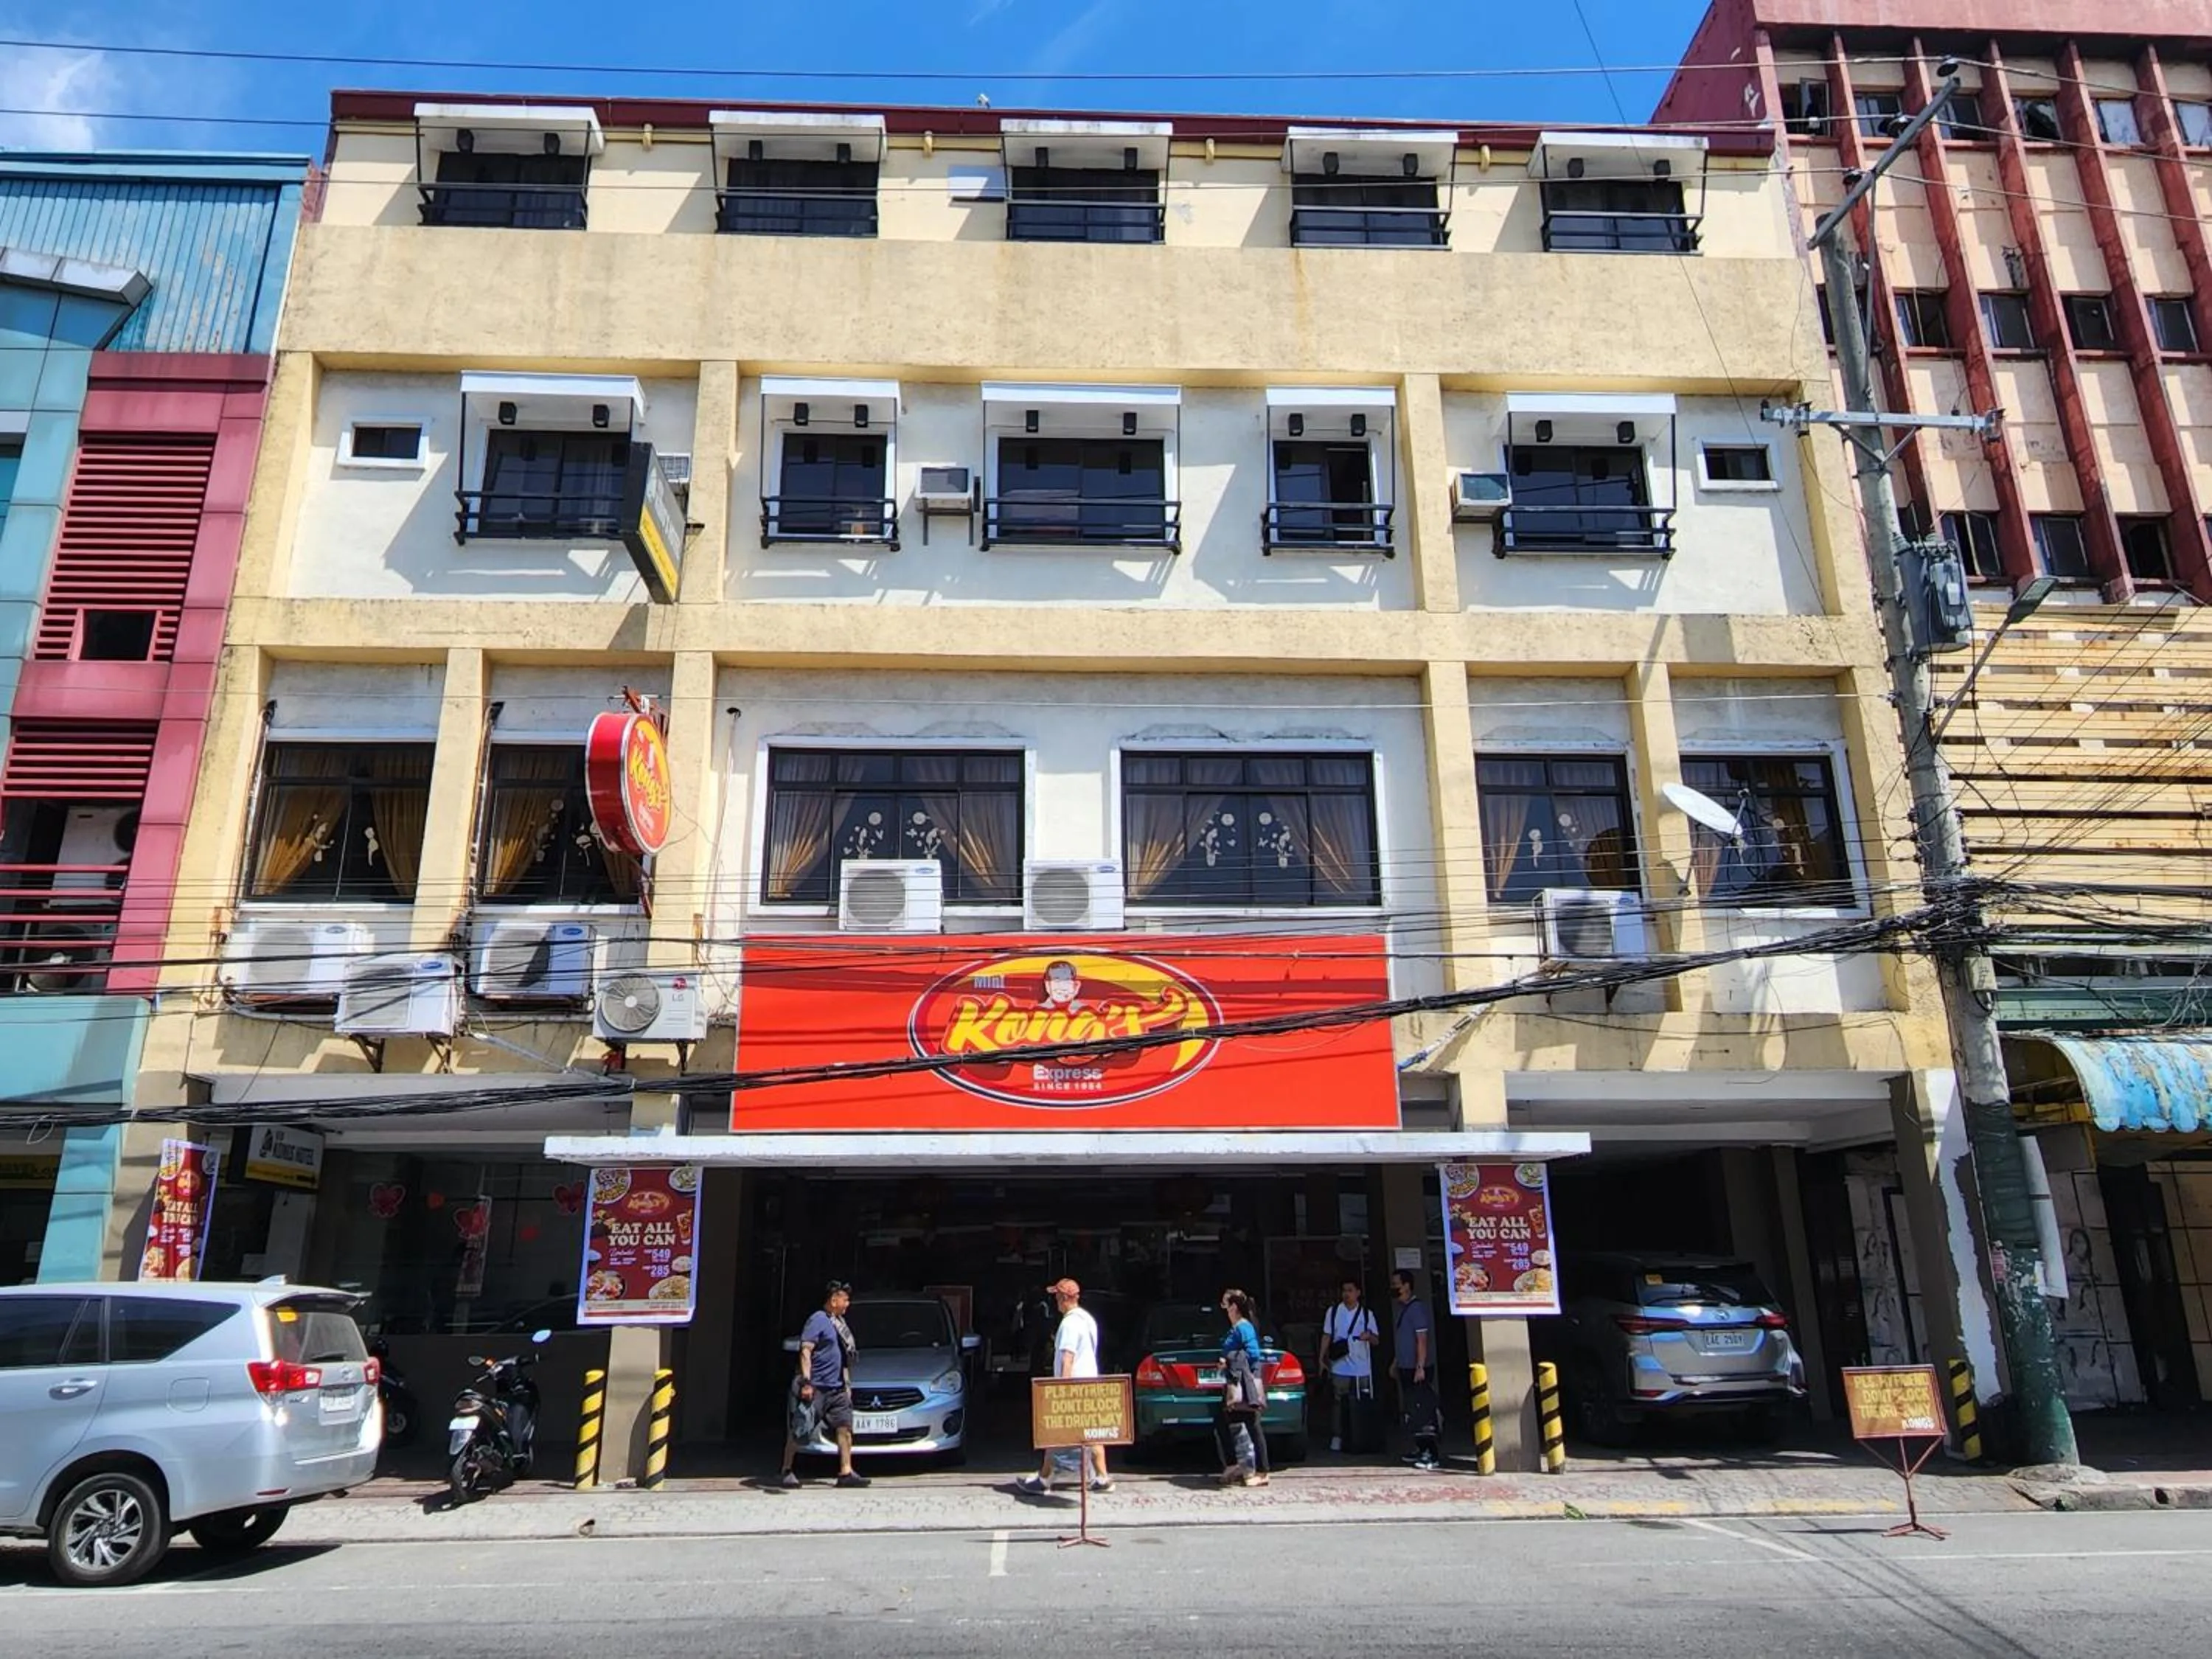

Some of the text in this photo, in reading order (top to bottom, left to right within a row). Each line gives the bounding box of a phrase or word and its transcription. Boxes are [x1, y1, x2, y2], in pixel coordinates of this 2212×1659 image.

[1033, 1063, 1102, 1083] Express
[1033, 1082, 1070, 1091] SINCE
[611, 1222, 674, 1234] EAT ALL
[1469, 1217, 1528, 1228] EAT ALL
[1467, 1228, 1531, 1239] YOU CAN
[608, 1234, 676, 1246] YOU CAN
[650, 1265, 670, 1276] 285
[1044, 1385, 1069, 1399] PLS.
[1051, 1397, 1122, 1413] DONT BLOCK
[1043, 1412, 1123, 1429] THE DRIVEWAY
[1083, 1427, 1120, 1440] KONGS
